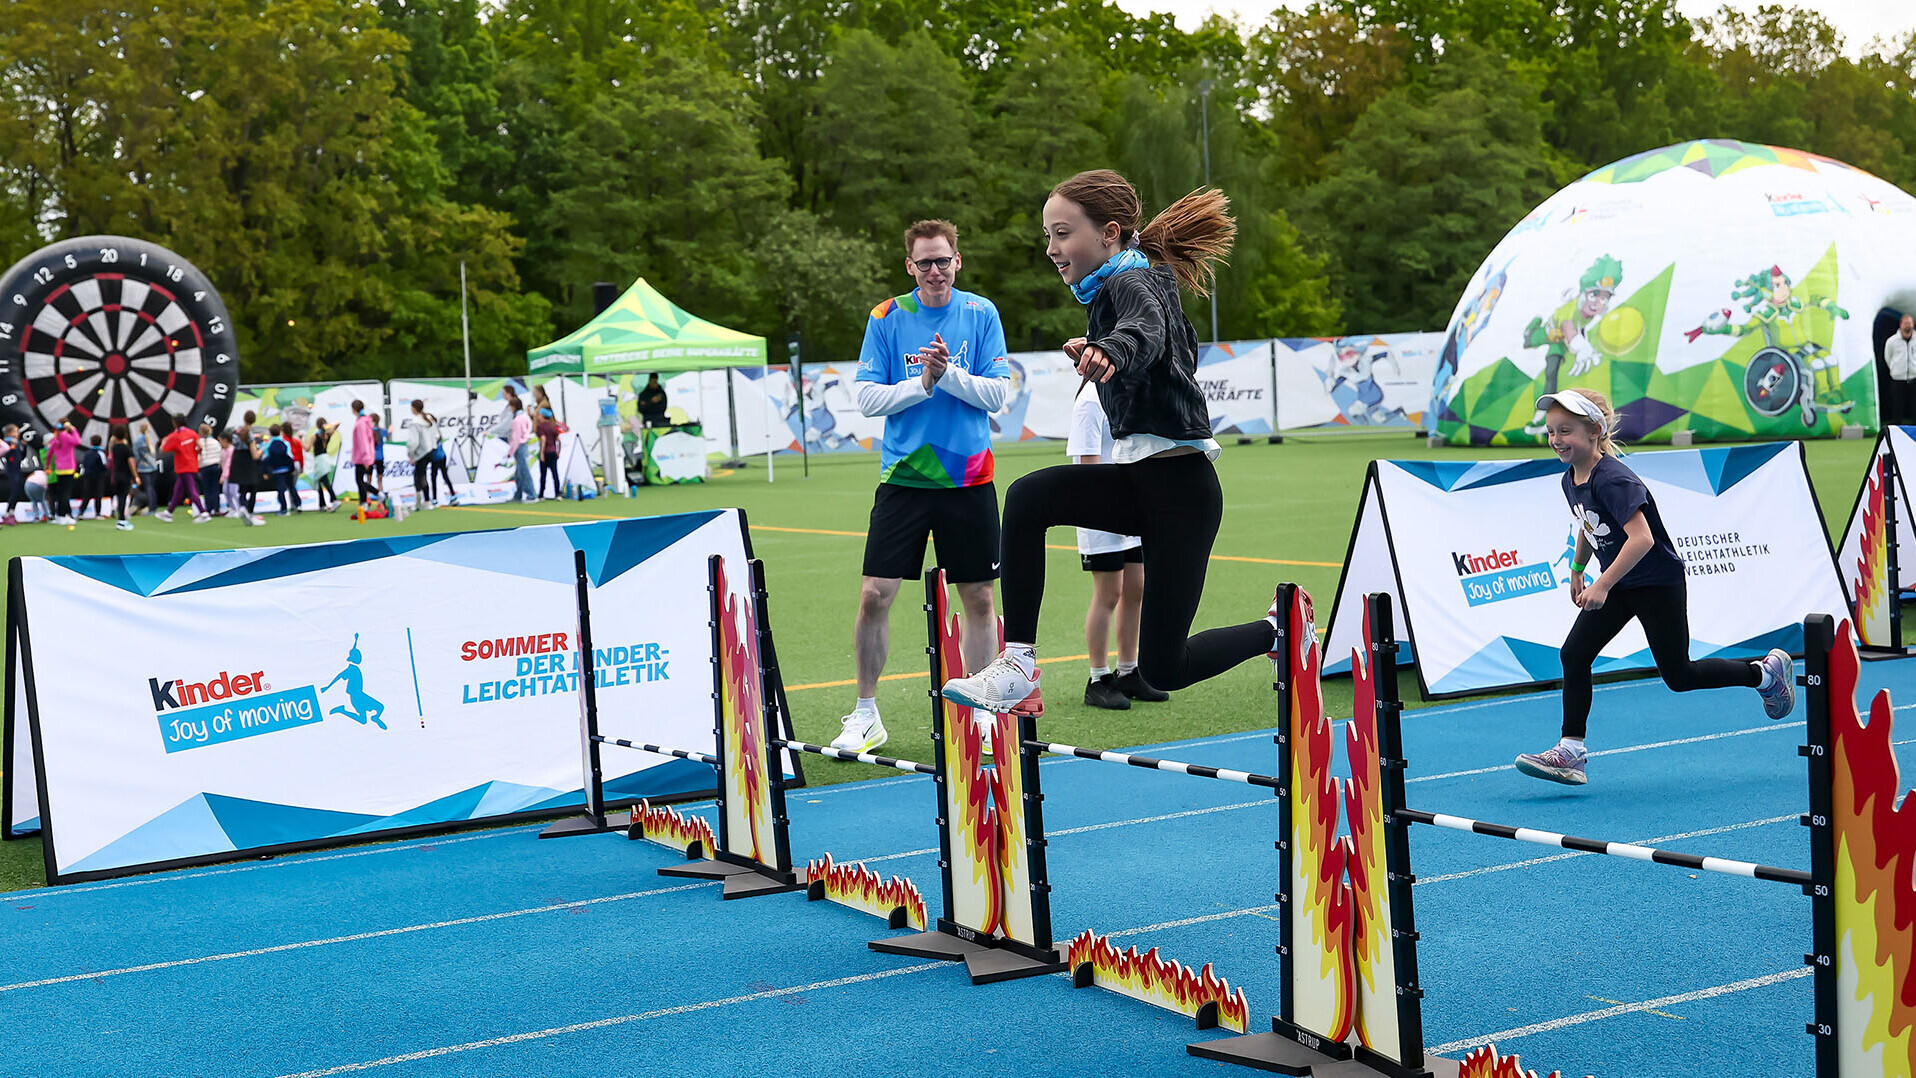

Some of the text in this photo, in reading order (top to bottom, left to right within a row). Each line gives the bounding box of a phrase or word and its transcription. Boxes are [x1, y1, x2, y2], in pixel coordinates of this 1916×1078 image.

[64, 254, 78, 270] 5
[100, 248, 118, 264] 20
[140, 252, 148, 266] 1
[33, 266, 55, 286] 12
[166, 264, 184, 282] 18
[13, 293, 28, 307] 9
[194, 290, 206, 302] 4
[0, 322, 14, 340] 14
[208, 315, 225, 335] 13
[213, 382, 229, 400] 10
[2, 394, 18, 406] 8
[1677, 532, 1740, 548] DEUTSCHER
[1680, 544, 1770, 562] LEICHTATHLETIK
[1686, 562, 1736, 576] VERBAND
[1468, 570, 1552, 600] Joy of moving
[460, 632, 568, 662] SOMMER
[1372, 642, 1378, 651] 80
[516, 654, 565, 676] DER
[1808, 675, 1821, 685] 80
[1376, 700, 1382, 708] 70
[168, 698, 314, 742] Joy of moving
[1810, 745, 1823, 756] 70
[1279, 788, 1286, 797] 50
[1384, 814, 1390, 823] 50
[1812, 815, 1826, 826] 60
[1279, 841, 1287, 850] 40
[1280, 894, 1287, 902] 30
[1815, 886, 1828, 896] 50
[1281, 946, 1288, 955] 20
[1816, 955, 1830, 966] 40
[1818, 1024, 1831, 1035] 30
